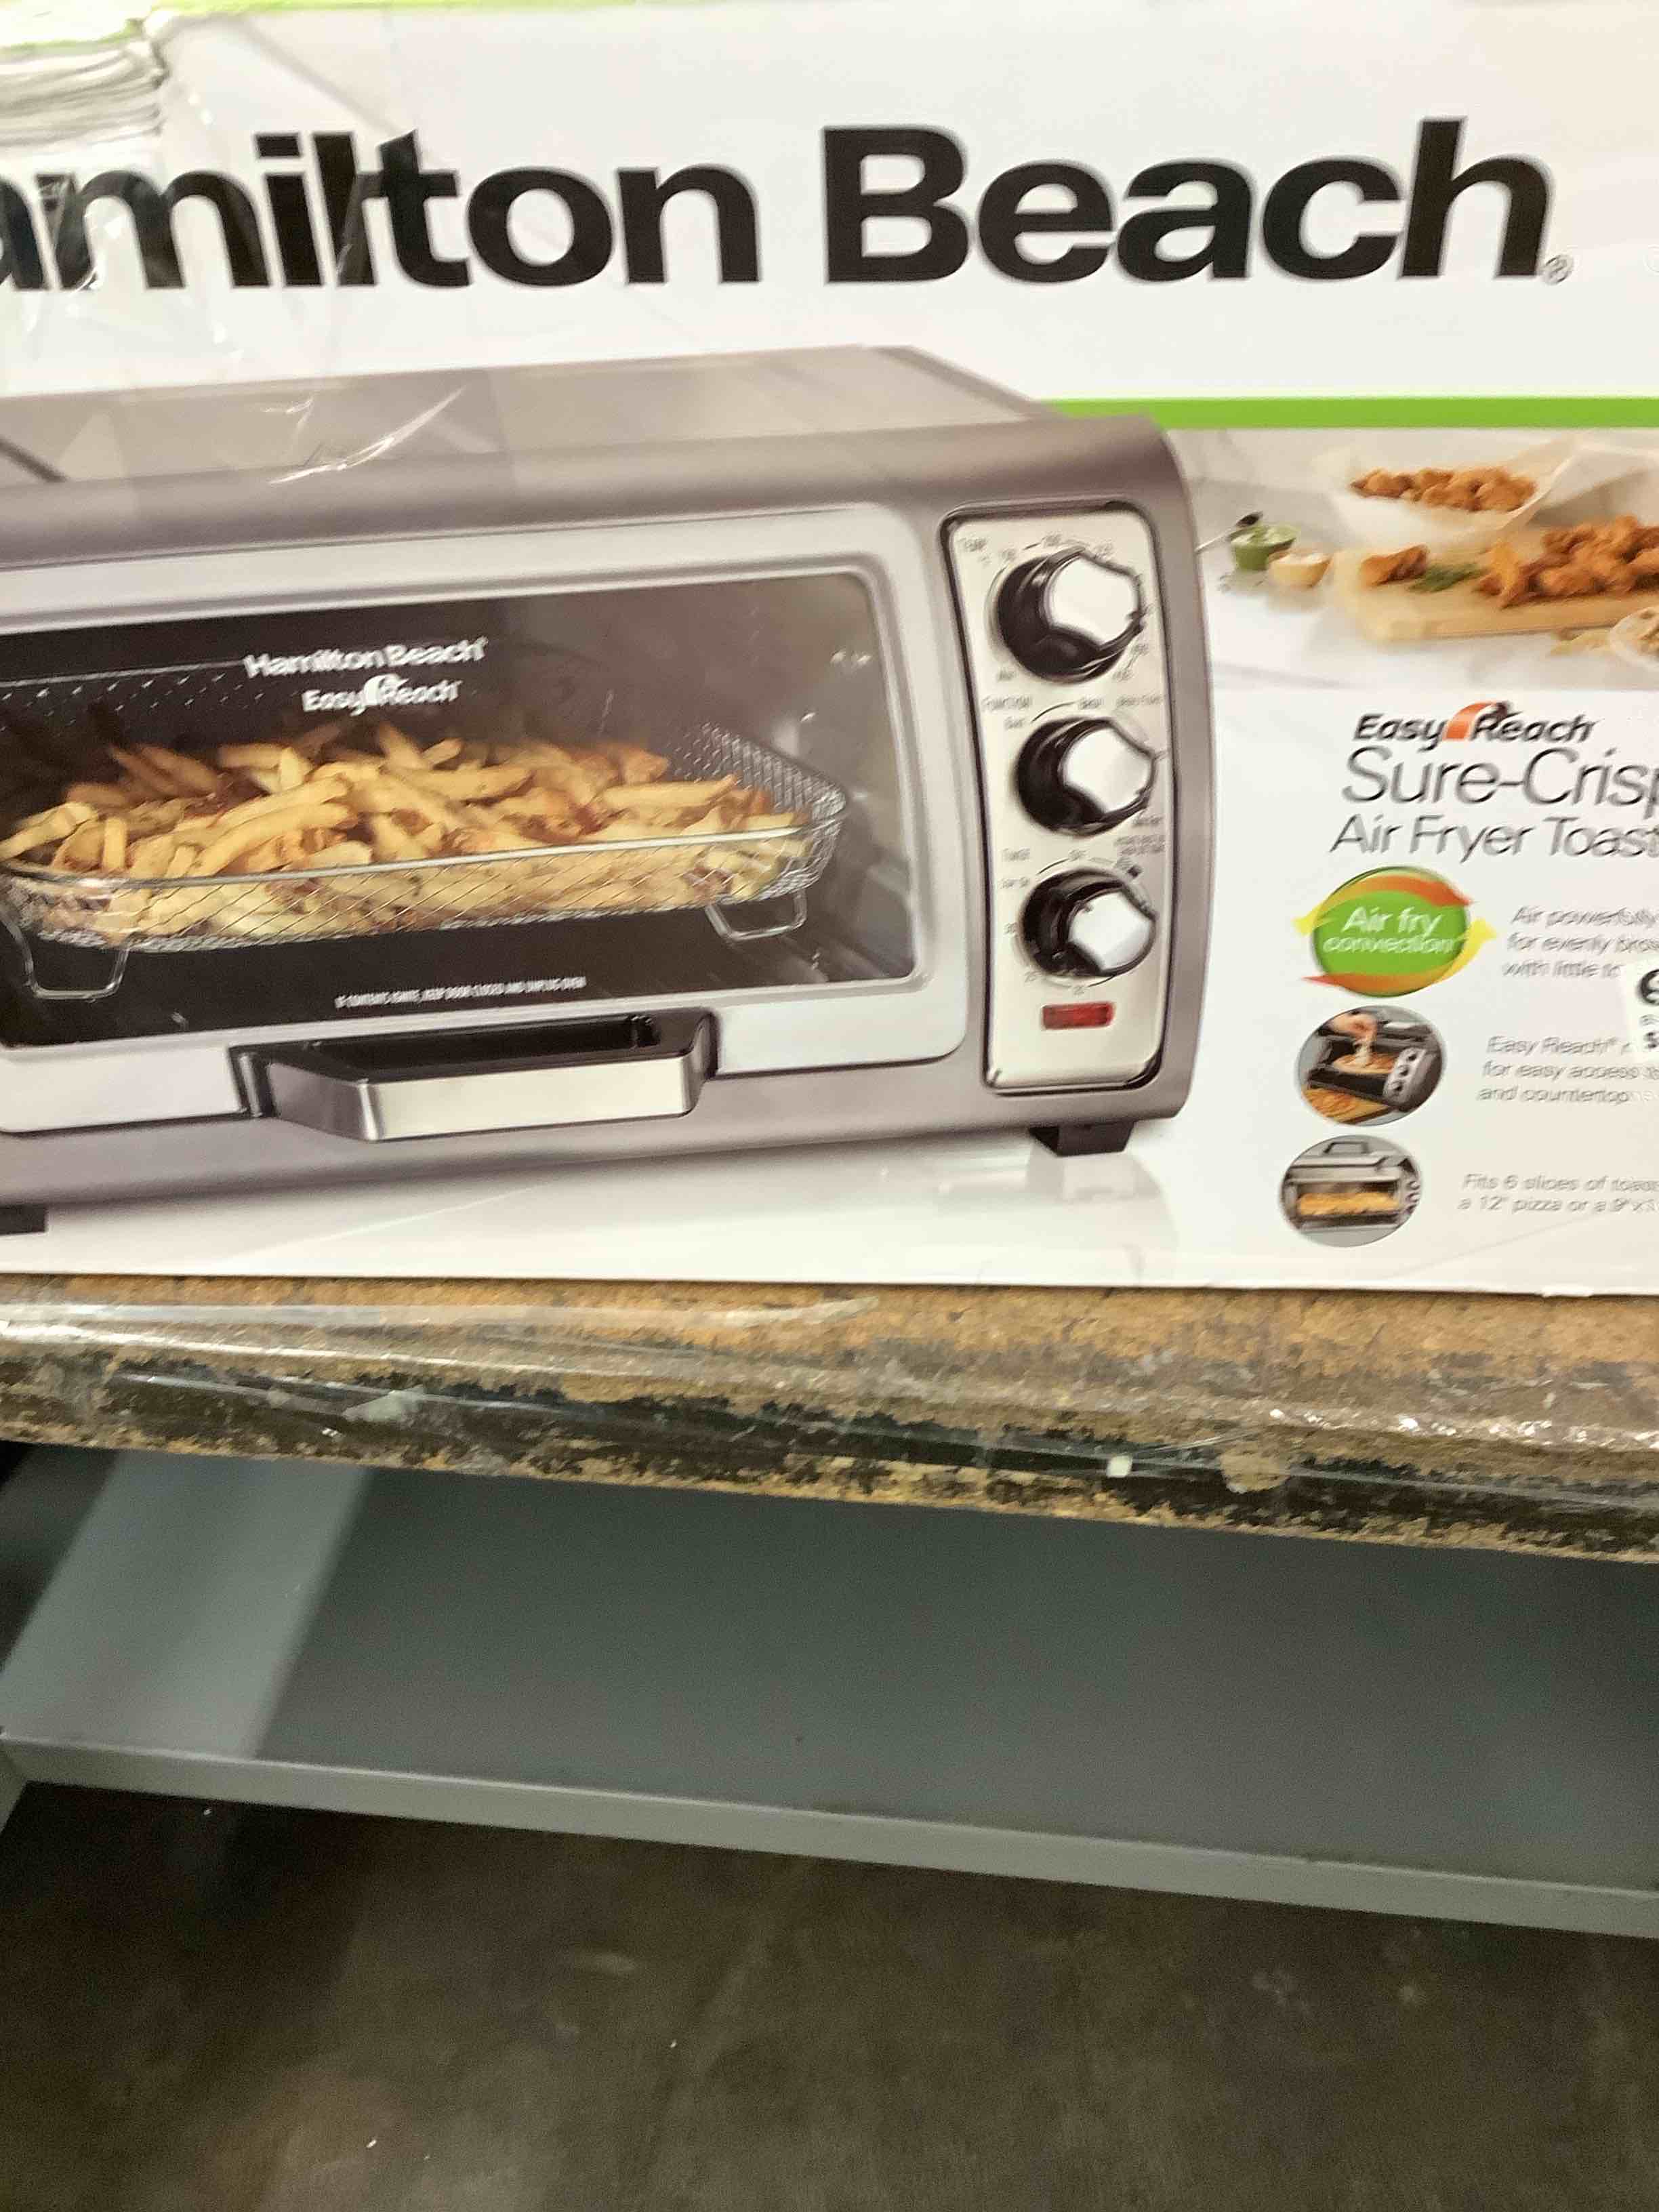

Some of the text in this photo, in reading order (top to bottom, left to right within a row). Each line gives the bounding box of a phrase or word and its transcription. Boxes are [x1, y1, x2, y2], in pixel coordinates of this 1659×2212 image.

[820, 115, 1554, 283] Beach
[1353, 701, 1598, 752] Easy Reach
[1328, 813, 1403, 854] Air
[1408, 815, 1536, 864] Fryer
[1340, 905, 1443, 939] Air fry
[1486, 1035, 1538, 1054] Easy
[1477, 1086, 1518, 1101] and
[1512, 1198, 1562, 1213] pizza
